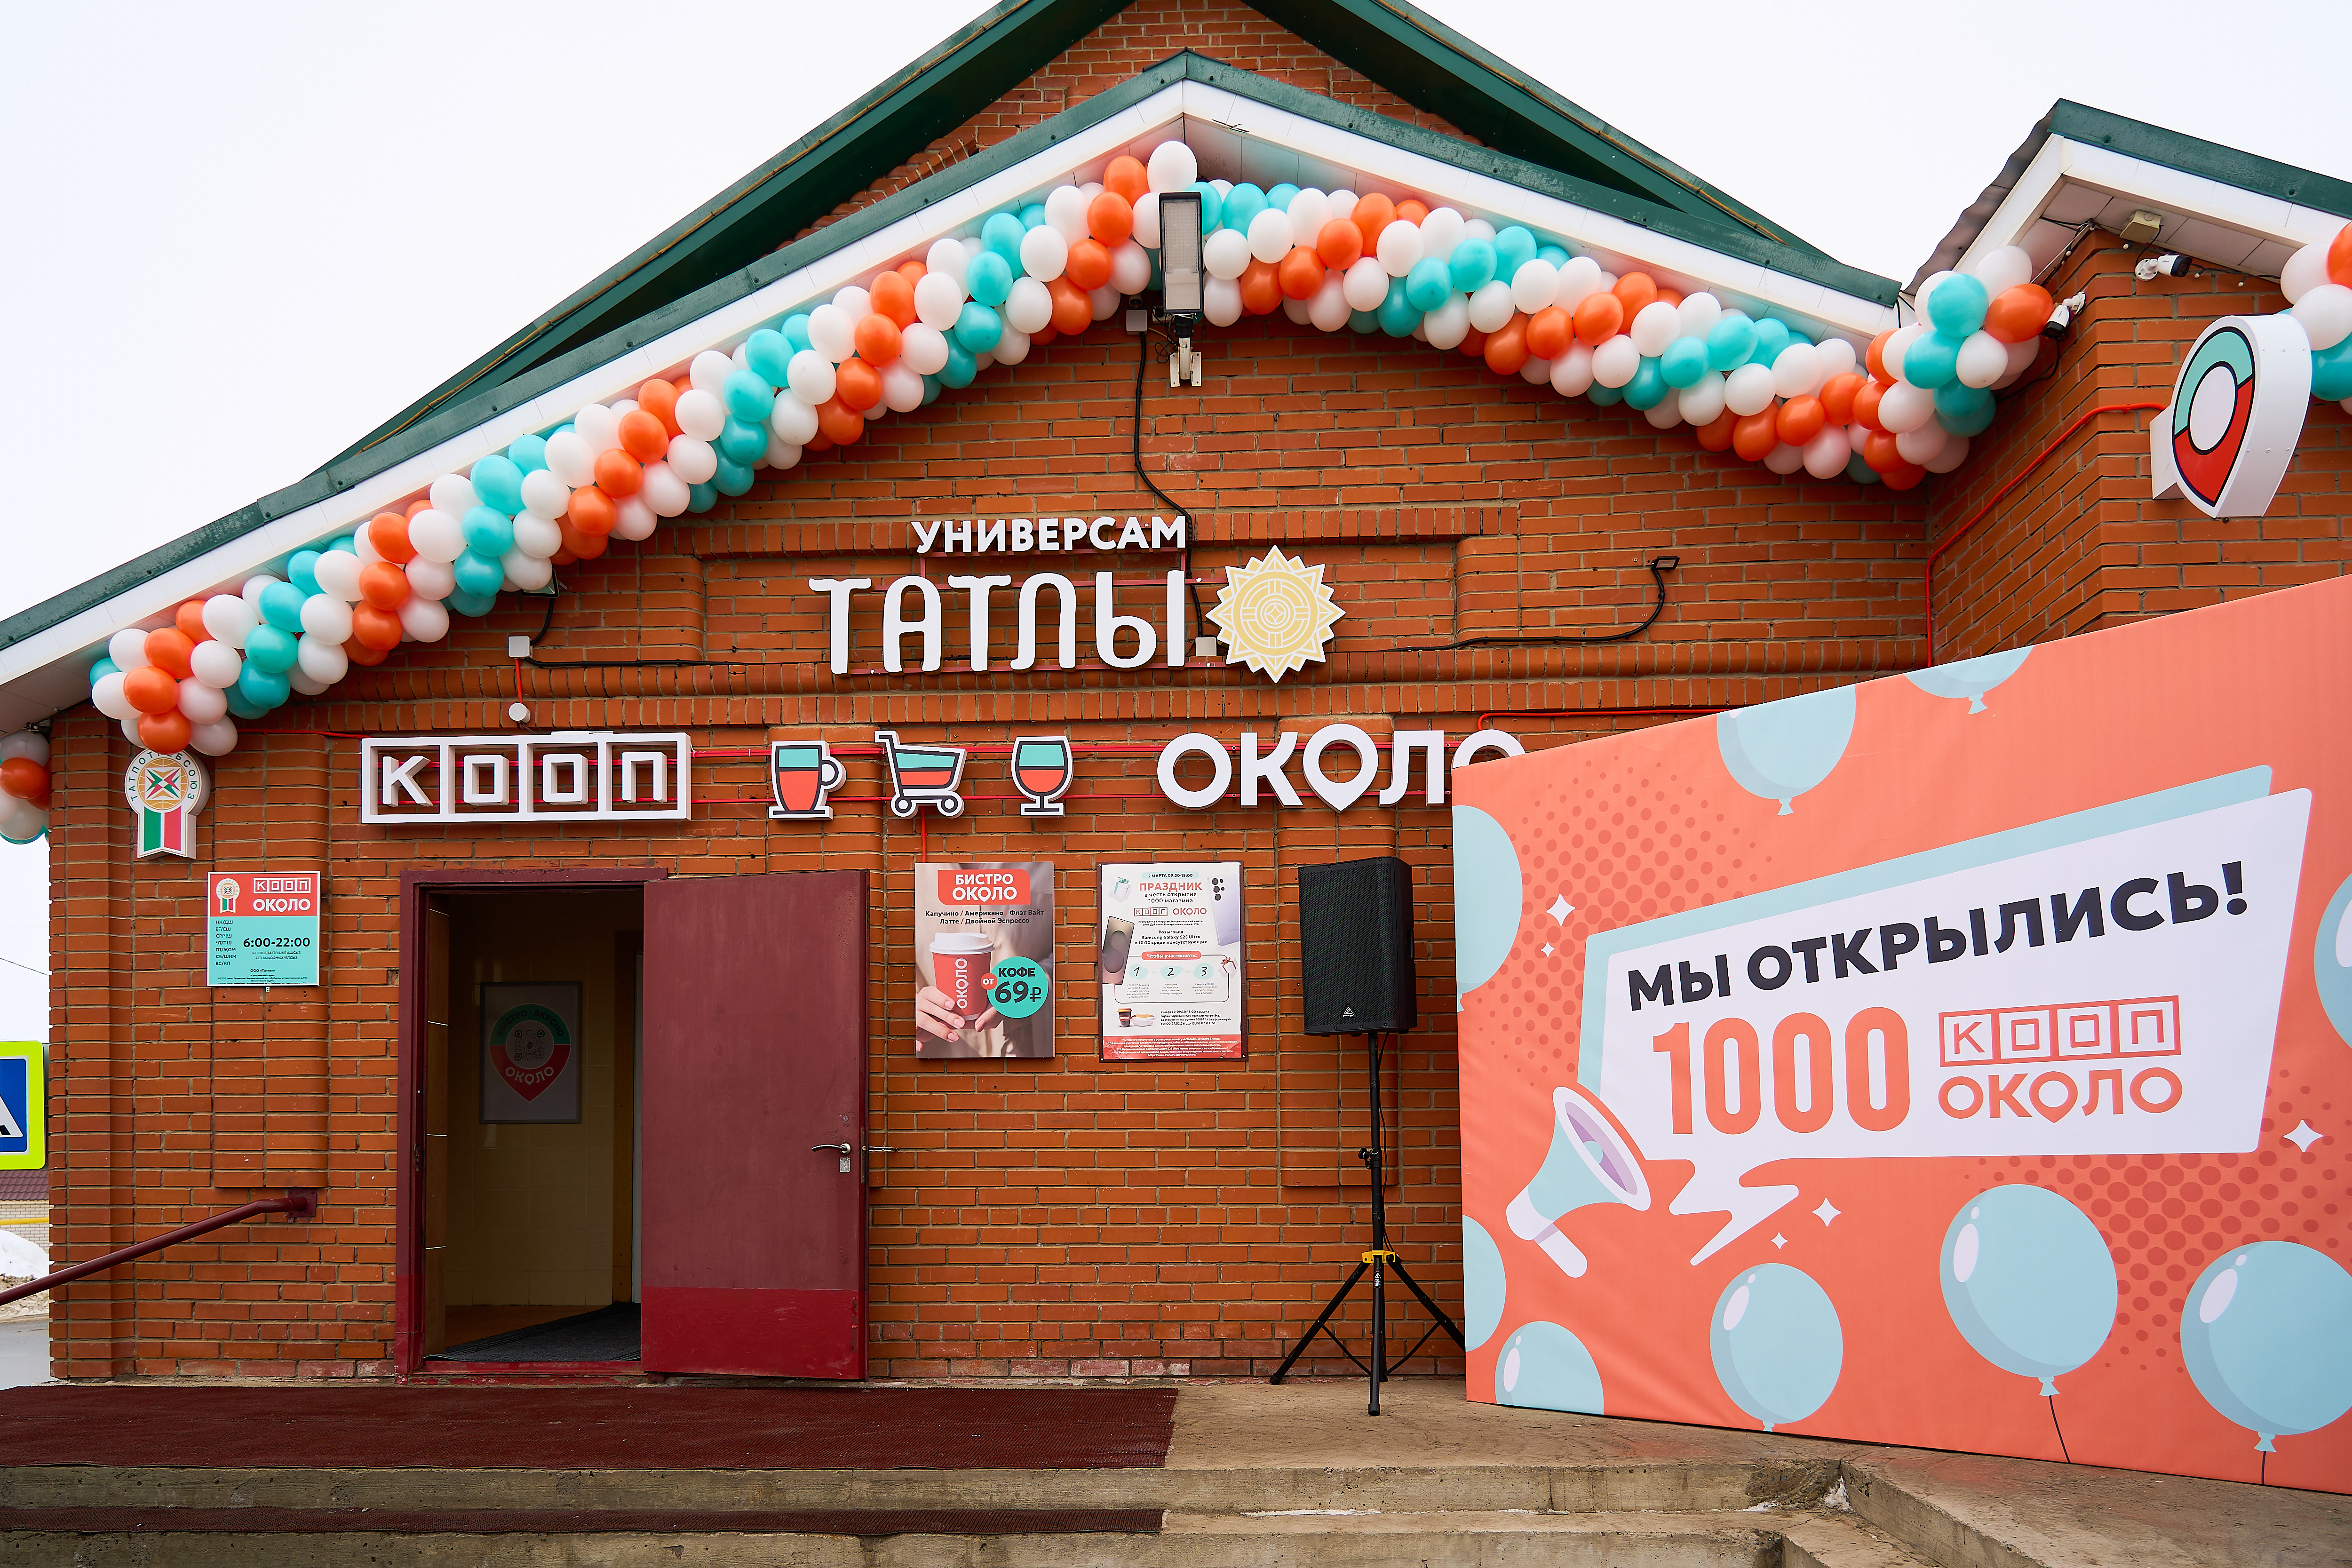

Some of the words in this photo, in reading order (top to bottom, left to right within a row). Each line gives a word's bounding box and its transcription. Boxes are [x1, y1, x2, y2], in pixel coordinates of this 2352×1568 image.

[911, 516, 1185, 554] УНИВЕРСАМ
[808, 570, 1185, 675] ТАТЛЫ
[128, 751, 197, 801] ТАТПОТБСОЮЗ
[382, 751, 667, 807] КООП
[257, 881, 307, 891] КООП
[955, 874, 1014, 885] БИСТРО
[1139, 882, 1202, 892] ПРАЗДНИК
[253, 898, 311, 913] ОКОЛО
[953, 886, 1017, 902] ОКОЛО
[243, 937, 310, 947] 6:00-22:00
[1627, 954, 1732, 1011] МЫ
[1747, 860, 2248, 990] ОТКРЫЛИСЬ!
[955, 958, 969, 1009] ОКОЛО
[998, 967, 1035, 978] КОФЕ
[1134, 967, 1140, 976] 1
[1167, 968, 1174, 976] 2
[1200, 966, 1208, 976] 3
[496, 1010, 527, 1036] БЫСТРО
[534, 1010, 564, 1036] ВКУСНО
[1953, 1009, 2166, 1055] КООП
[505, 1067, 554, 1085] ОКОЛО
[1652, 1006, 1911, 1135] 1000
[1938, 1067, 2183, 1124] ОКОЛО
